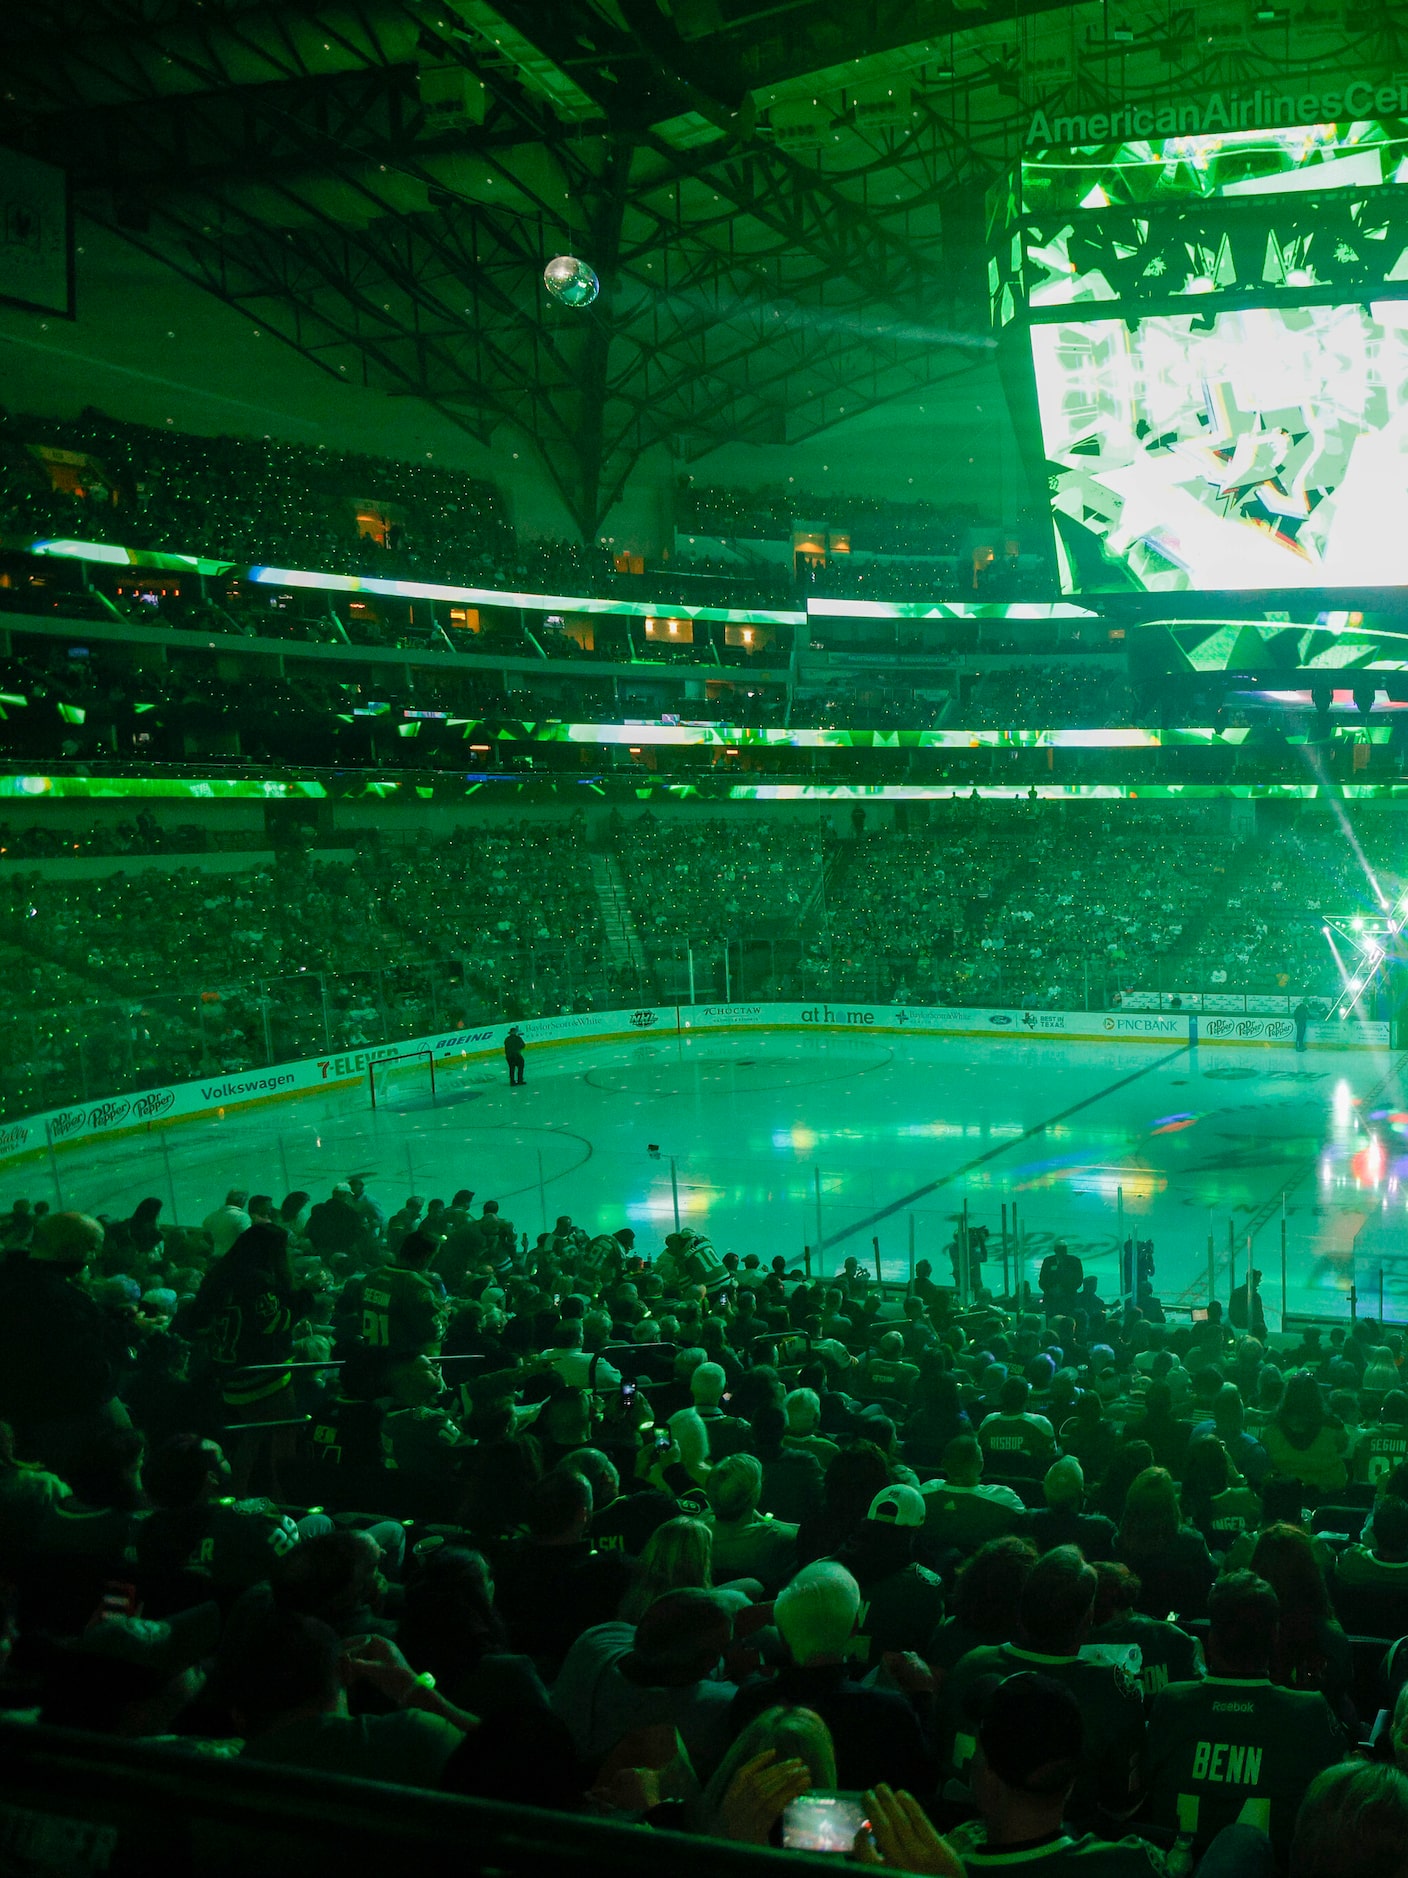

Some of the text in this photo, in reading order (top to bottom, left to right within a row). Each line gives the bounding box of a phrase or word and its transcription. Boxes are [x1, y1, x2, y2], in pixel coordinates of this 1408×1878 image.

[801, 1007, 820, 1024] at
[436, 1031, 494, 1049] BOEING
[201, 1073, 295, 1101] Volkswagen
[363, 1309, 390, 1346] 91
[1370, 1439, 1406, 1451] SEGUIN
[1212, 1700, 1255, 1714] Reebok
[1192, 1741, 1264, 1786] BENN
